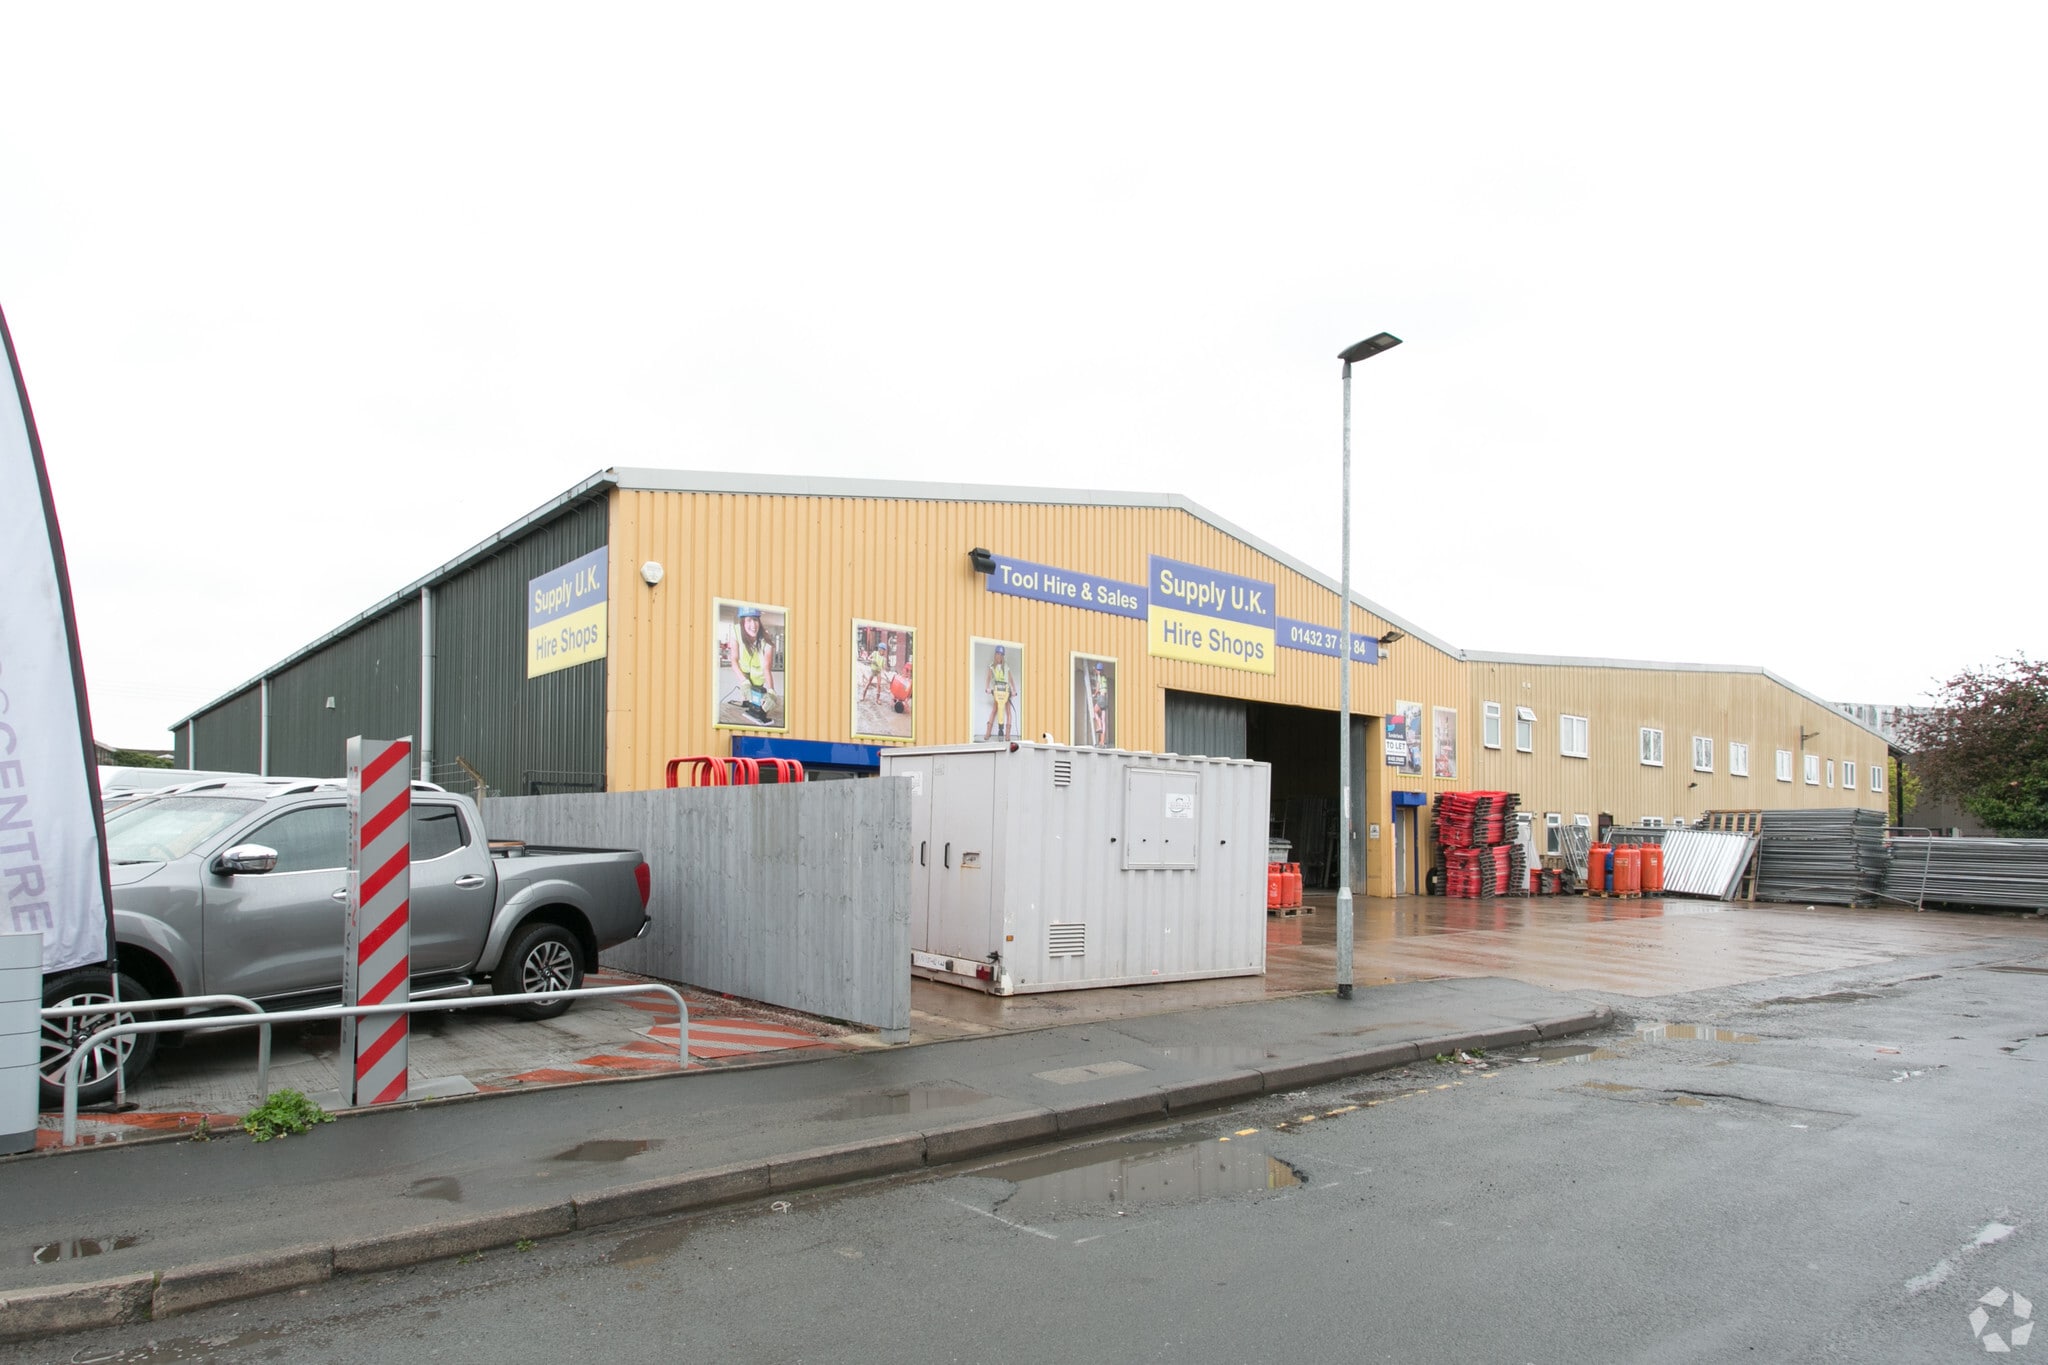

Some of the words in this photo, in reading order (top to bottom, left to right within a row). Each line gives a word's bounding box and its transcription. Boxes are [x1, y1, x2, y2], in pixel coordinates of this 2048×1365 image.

[534, 578, 572, 614] Supply
[575, 565, 600, 598] U.K.
[1000, 565, 1038, 590] Tool
[1044, 574, 1076, 598] Hire
[1081, 582, 1093, 601] &
[1097, 585, 1138, 610] Sales
[1160, 569, 1226, 612] Supply
[1231, 585, 1266, 615] U.K.
[536, 635, 557, 660] Hire
[560, 624, 598, 653] Shops
[1164, 619, 1202, 649] Hire
[1208, 628, 1264, 663] Shops
[1291, 626, 1323, 647] 01432
[1325, 633, 1338, 649] 37
[1353, 640, 1366, 656] 84
[1386, 741, 1394, 749] TO
[1395, 742, 1406, 750] LET
